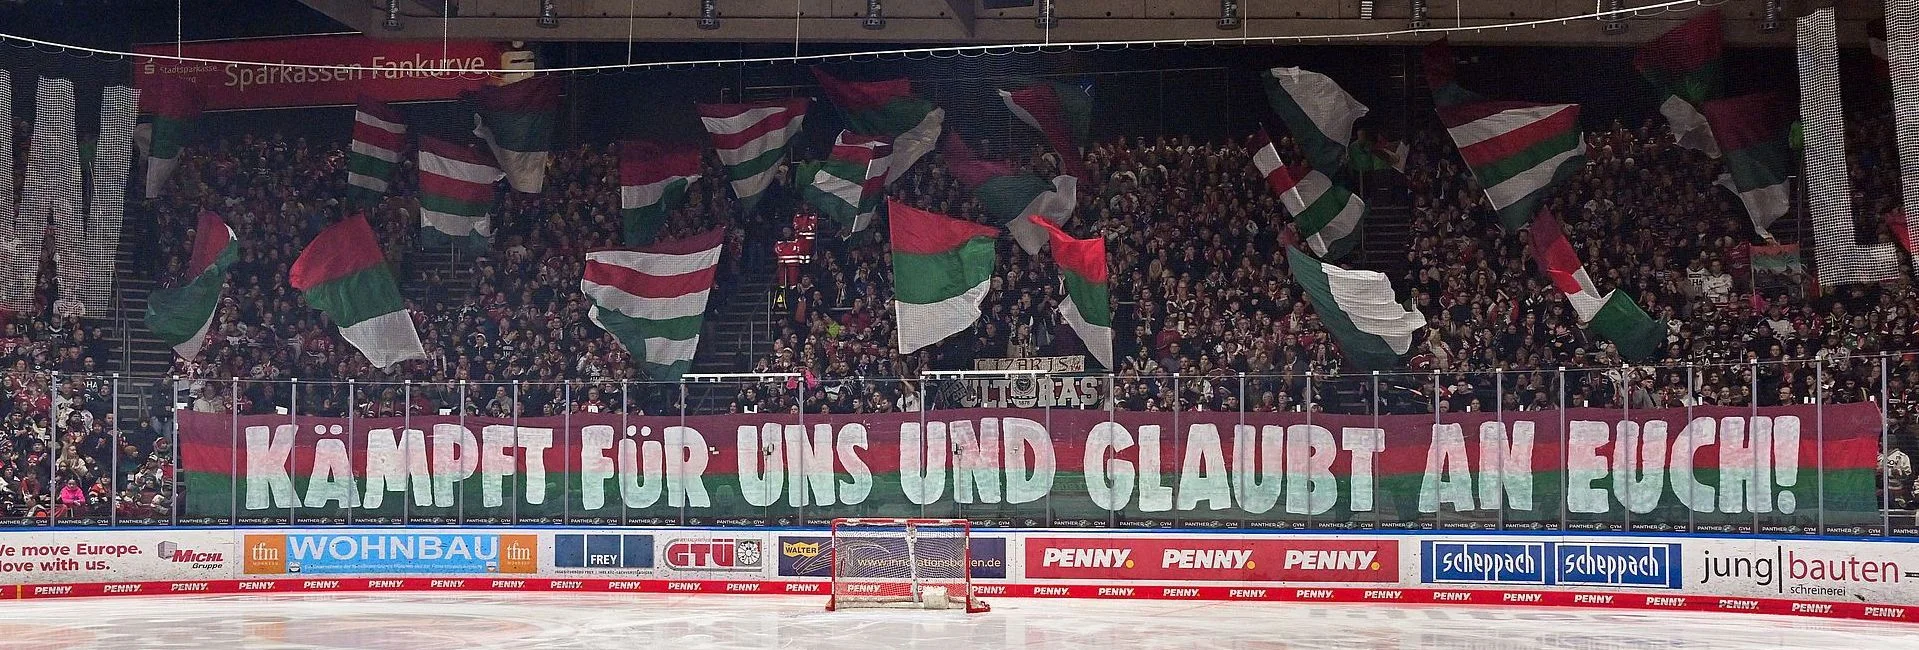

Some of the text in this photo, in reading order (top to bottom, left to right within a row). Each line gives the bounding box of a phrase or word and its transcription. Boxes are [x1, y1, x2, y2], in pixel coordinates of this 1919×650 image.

[160, 65, 218, 75] Stadtsparkasse
[224, 53, 486, 91] Sparkassen Fankurve
[960, 376, 1099, 408] ULTRAS
[245, 415, 1801, 515] KÄMPFT FÜR UNS UND GLAUBT AN EUCH!
[22, 545, 75, 556] move
[77, 543, 143, 557] Europe.
[252, 542, 279, 561] tfm
[289, 535, 498, 560] WOHNBAU
[506, 541, 531, 561] tfm
[667, 538, 734, 567] GTÜ
[785, 546, 817, 554] WALTER
[0, 558, 111, 572] ove with us.
[192, 562, 223, 570] Gruppe
[590, 554, 617, 565] FREY
[1443, 543, 1535, 582] scheppach
[1565, 544, 1659, 584] scheppach
[1790, 583, 1846, 596] schreinerei
